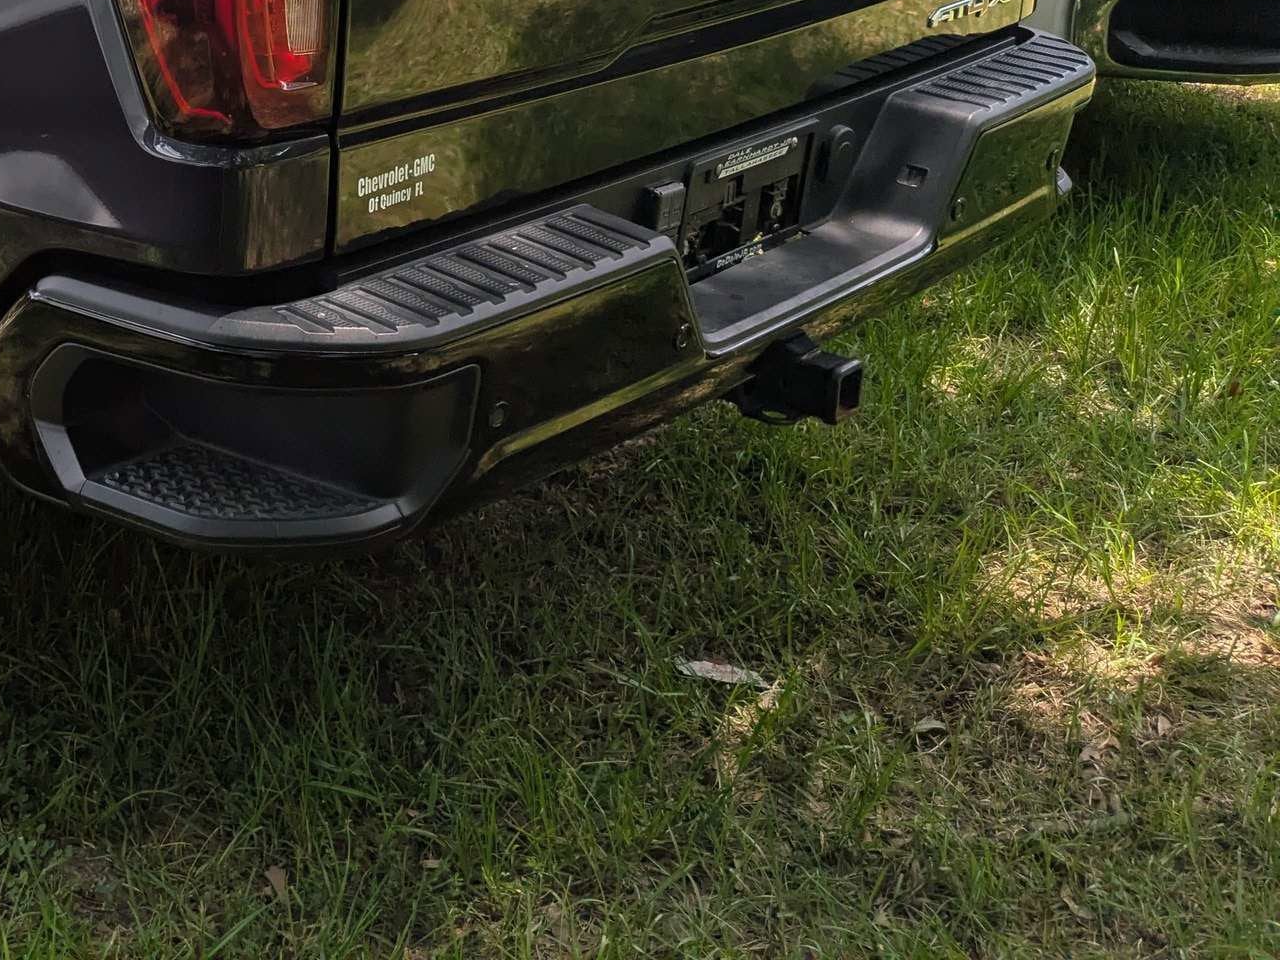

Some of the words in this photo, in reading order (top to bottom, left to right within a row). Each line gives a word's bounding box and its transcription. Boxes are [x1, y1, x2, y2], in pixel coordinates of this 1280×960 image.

[357, 153, 436, 197] Chevrolet-GMC
[380, 187, 412, 210] Quincy
[415, 181, 424, 197] FL
